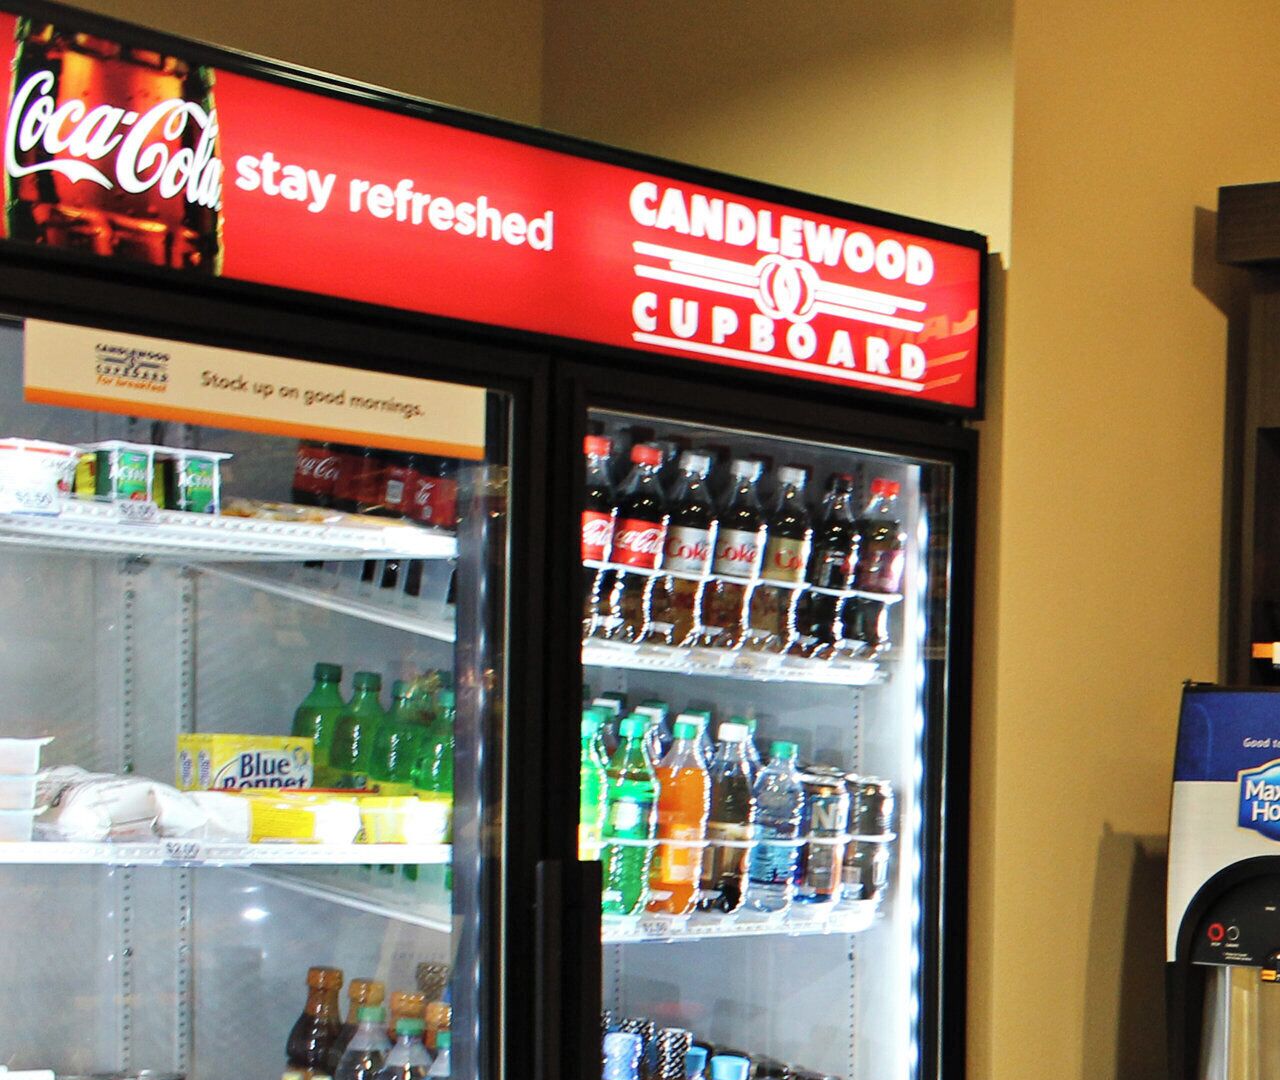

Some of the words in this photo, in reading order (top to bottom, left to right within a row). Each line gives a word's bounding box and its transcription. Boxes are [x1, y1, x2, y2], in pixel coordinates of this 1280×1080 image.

[4, 69, 221, 212] Coca-Cola
[236, 152, 335, 213] stay
[349, 180, 556, 252] refreshed
[629, 181, 935, 286] CANDLEWOOD
[632, 291, 927, 380] CUPBOARD
[201, 369, 247, 393] Stock
[256, 377, 274, 400] up
[281, 381, 300, 397] on
[305, 384, 347, 406] good
[351, 388, 426, 419] mornings.
[241, 752, 291, 779] Blue
